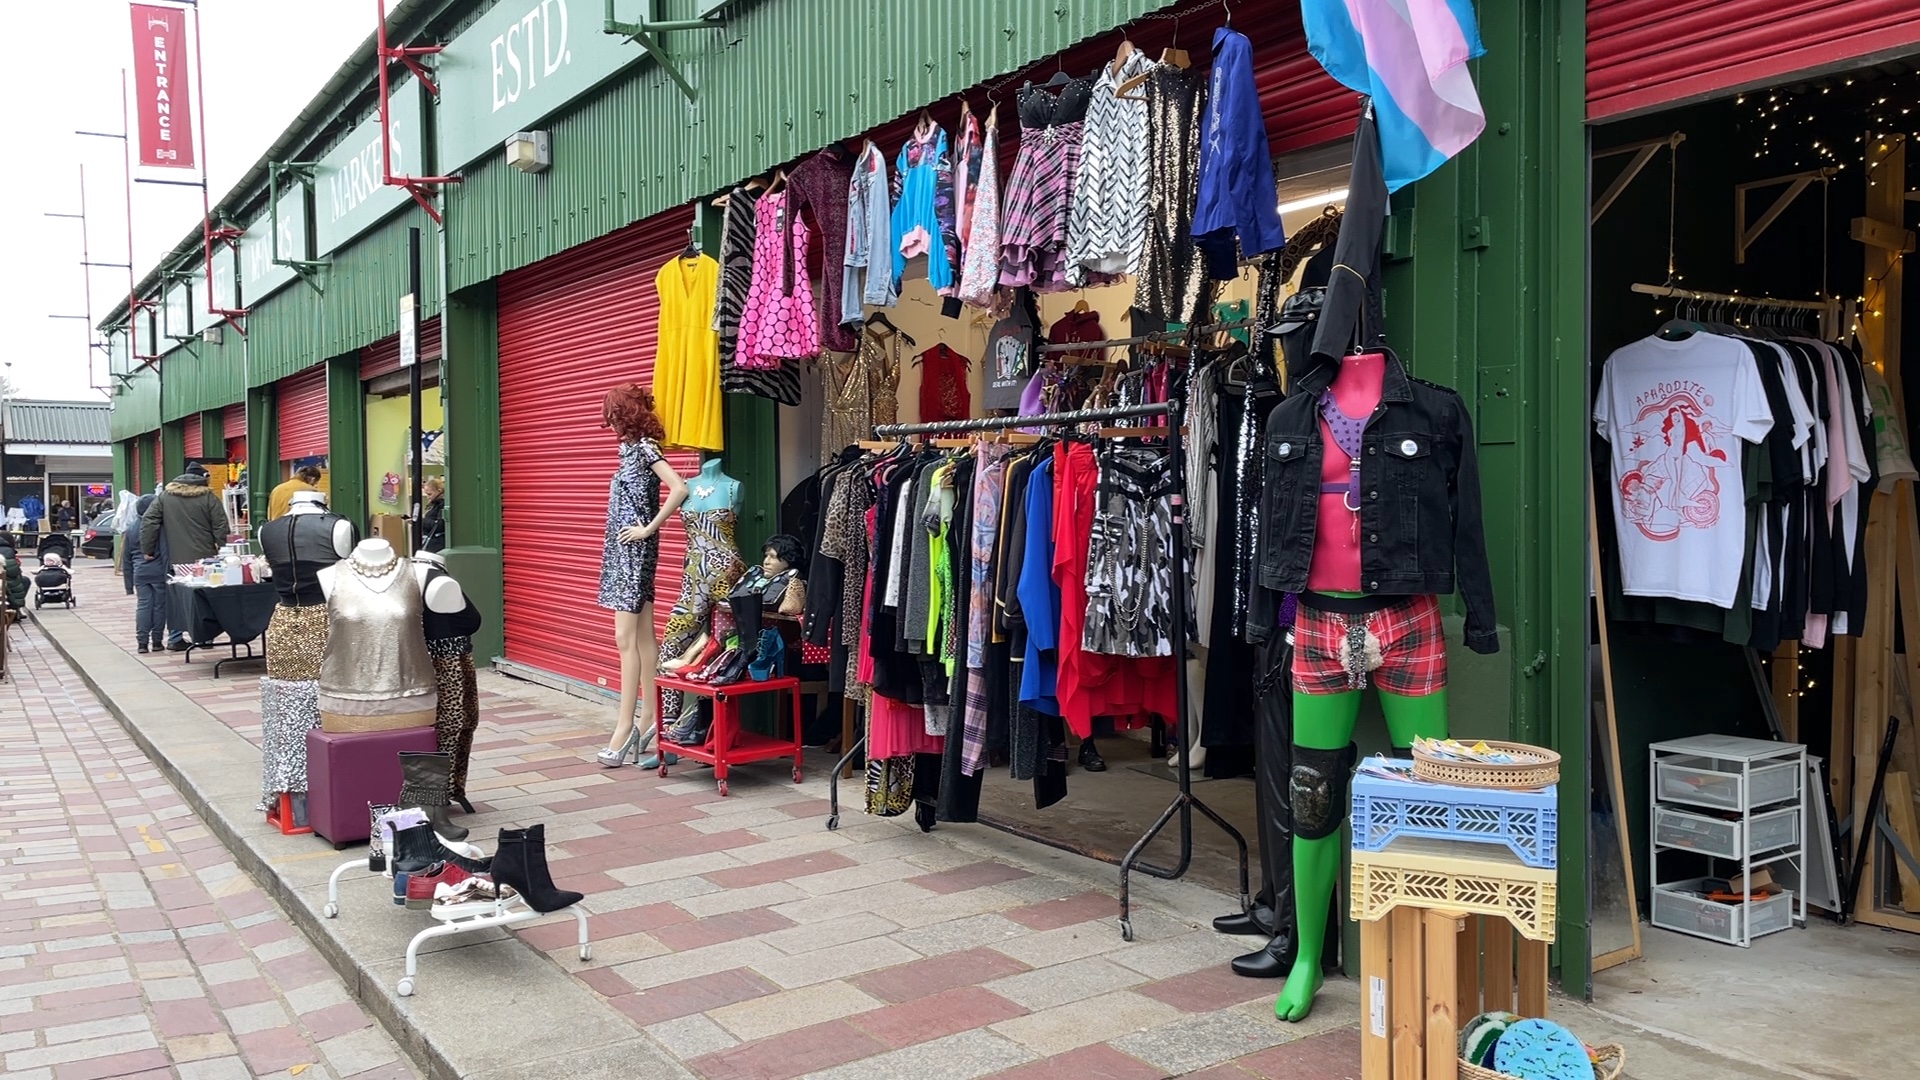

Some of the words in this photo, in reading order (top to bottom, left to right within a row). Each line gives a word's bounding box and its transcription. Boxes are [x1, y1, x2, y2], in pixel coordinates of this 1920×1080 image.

[153, 36, 171, 141] ENTRANCE
[490, 0, 571, 113] ESTD.
[330, 120, 402, 223] MARKES
[1635, 380, 1705, 407] APHRODITE
